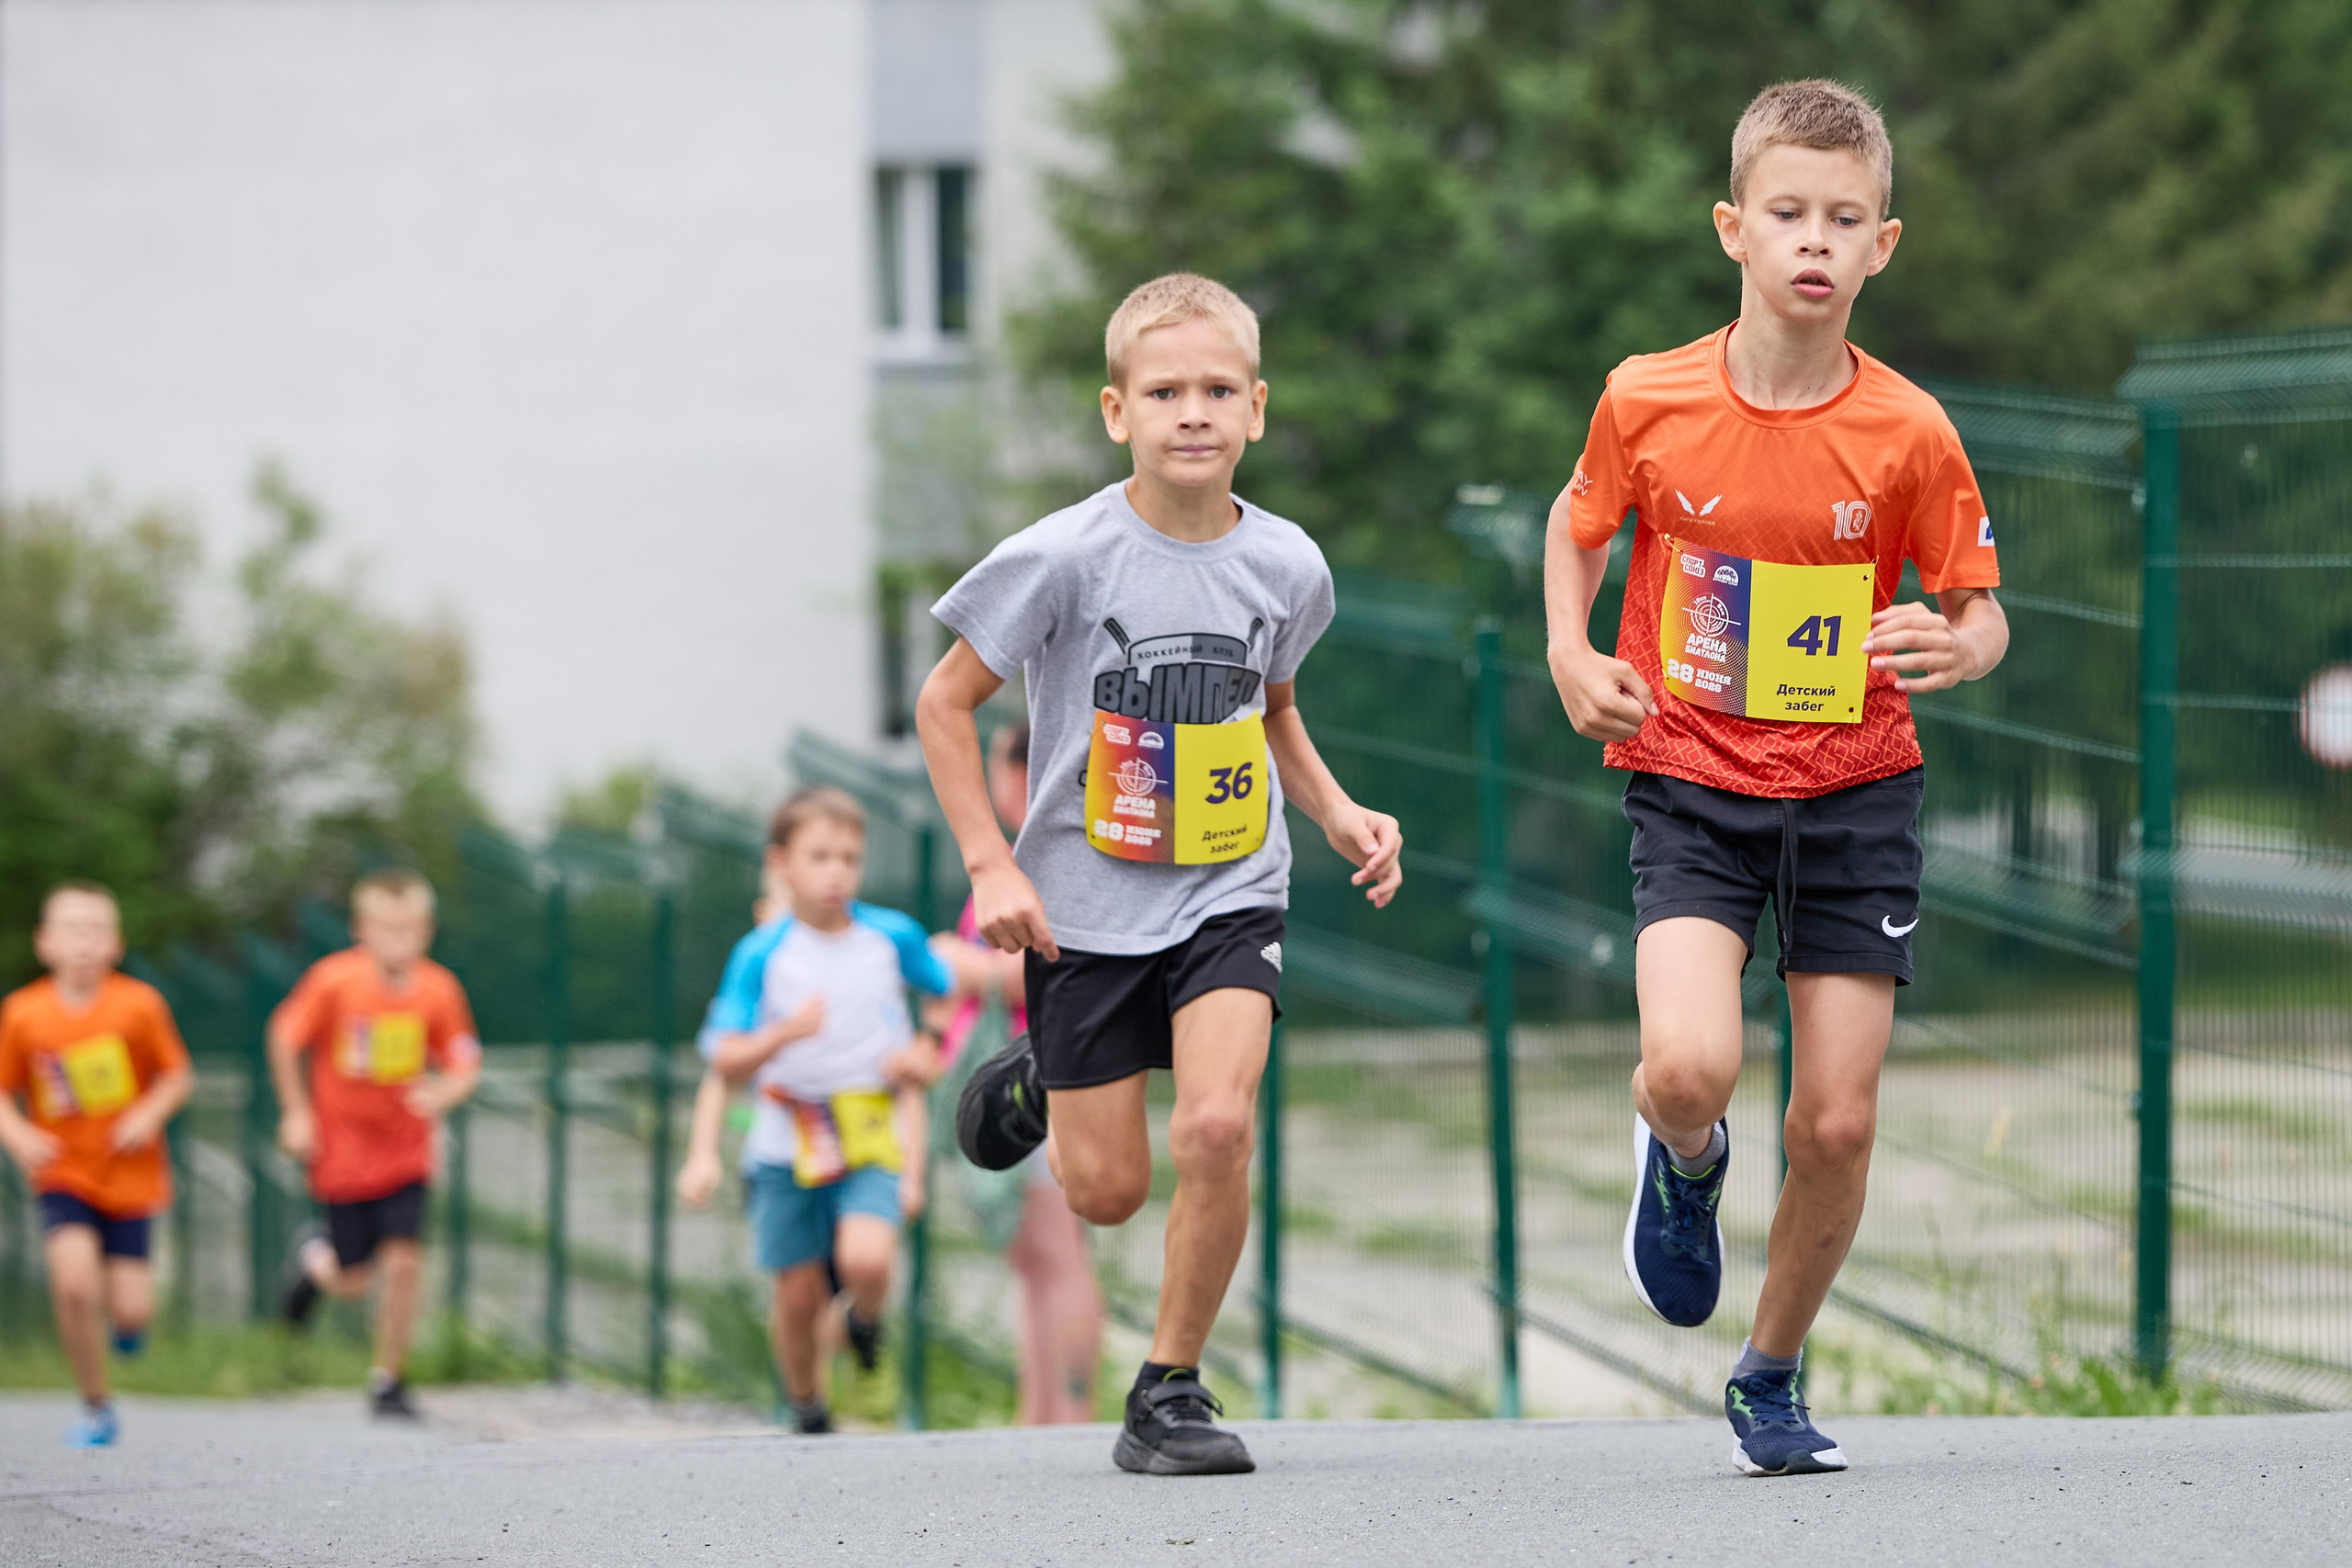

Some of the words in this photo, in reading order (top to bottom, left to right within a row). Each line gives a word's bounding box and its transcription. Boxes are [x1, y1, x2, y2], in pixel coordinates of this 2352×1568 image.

[1831, 501, 1871, 540] 10
[1684, 563, 1704, 576] СОЮЗ
[1687, 633, 1727, 654] АРЕНА
[1787, 615, 1841, 656] 41
[1137, 645, 1203, 660] ХОККЕЙНЫЙ
[1685, 646, 1726, 663] БИАТЛОНА
[1668, 659, 1694, 683] 28
[1696, 668, 1732, 686] ИЮНЯ
[1094, 662, 1261, 725] ВЫМПЕЛ
[1776, 683, 1836, 696] Детский
[1785, 701, 1824, 712] забег
[1205, 761, 1252, 805] 36
[1093, 819, 1125, 842] 28
[1202, 824, 1247, 841] Детский
